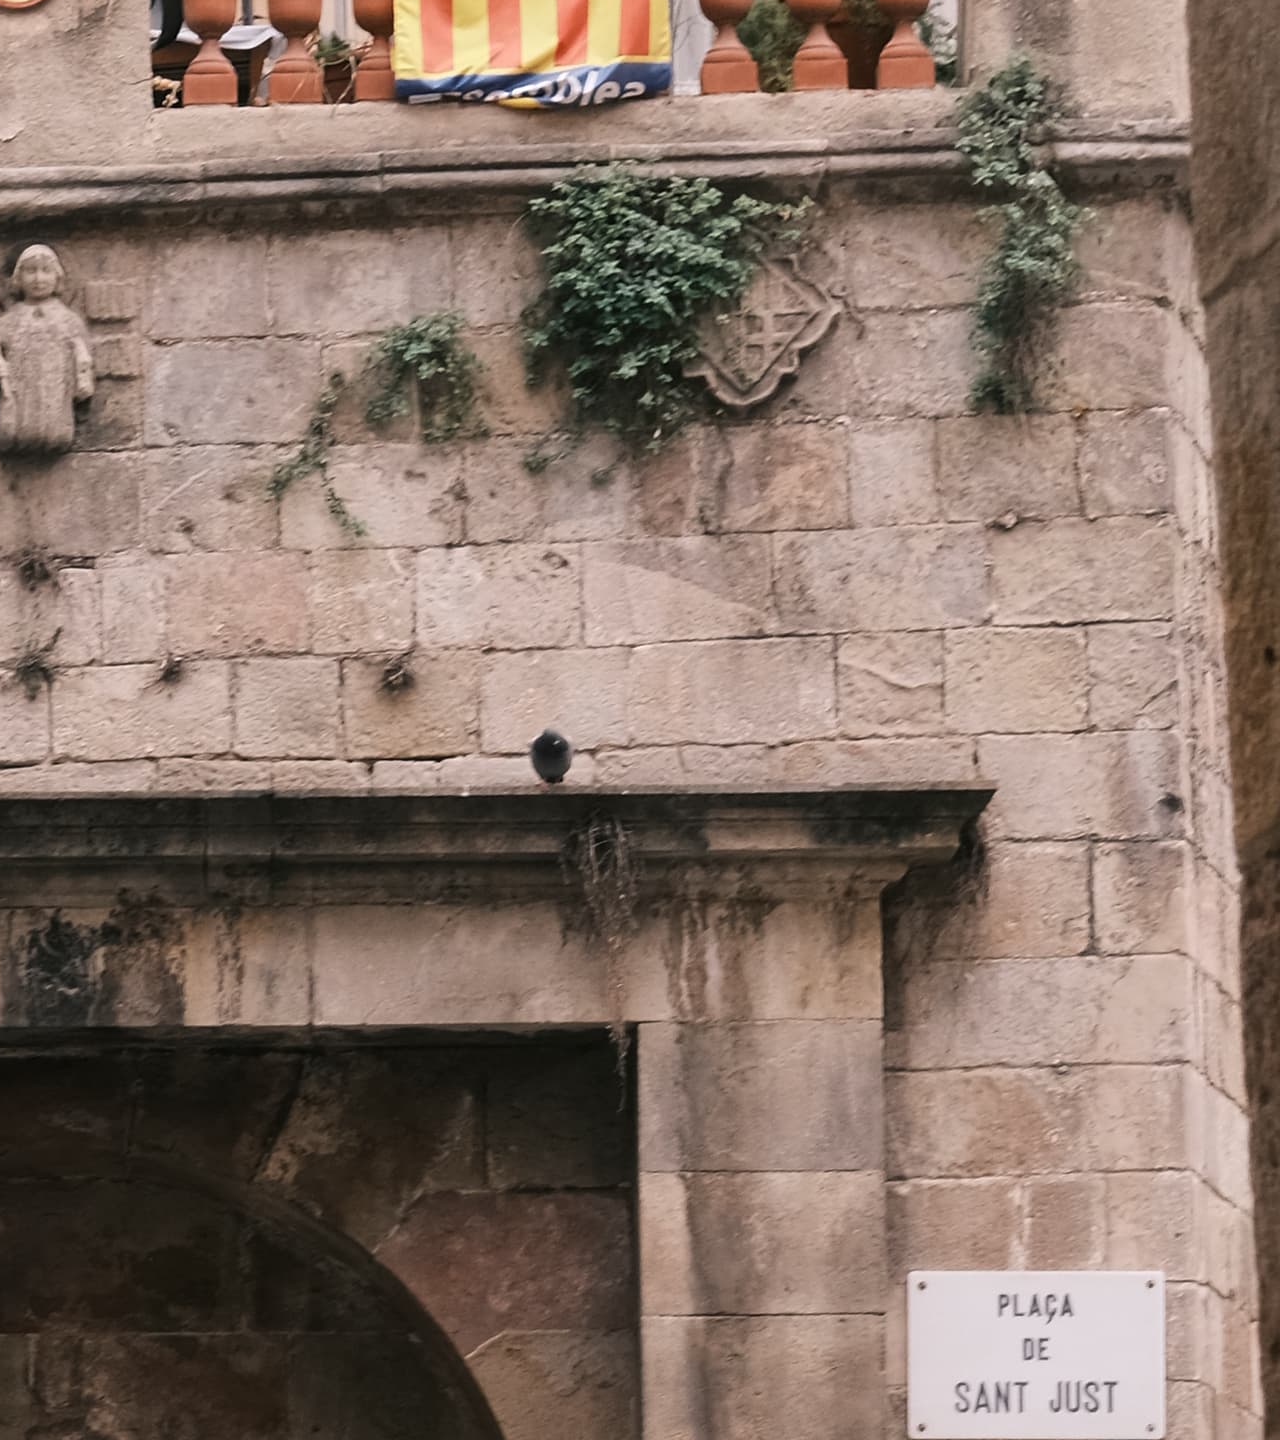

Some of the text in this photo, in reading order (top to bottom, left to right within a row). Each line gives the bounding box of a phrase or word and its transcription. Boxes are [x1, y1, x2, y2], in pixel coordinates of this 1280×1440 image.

[997, 1293, 1074, 1324] PLAÇA
[1023, 1337, 1051, 1361] DE
[954, 1381, 1118, 1414] SANT JUST
